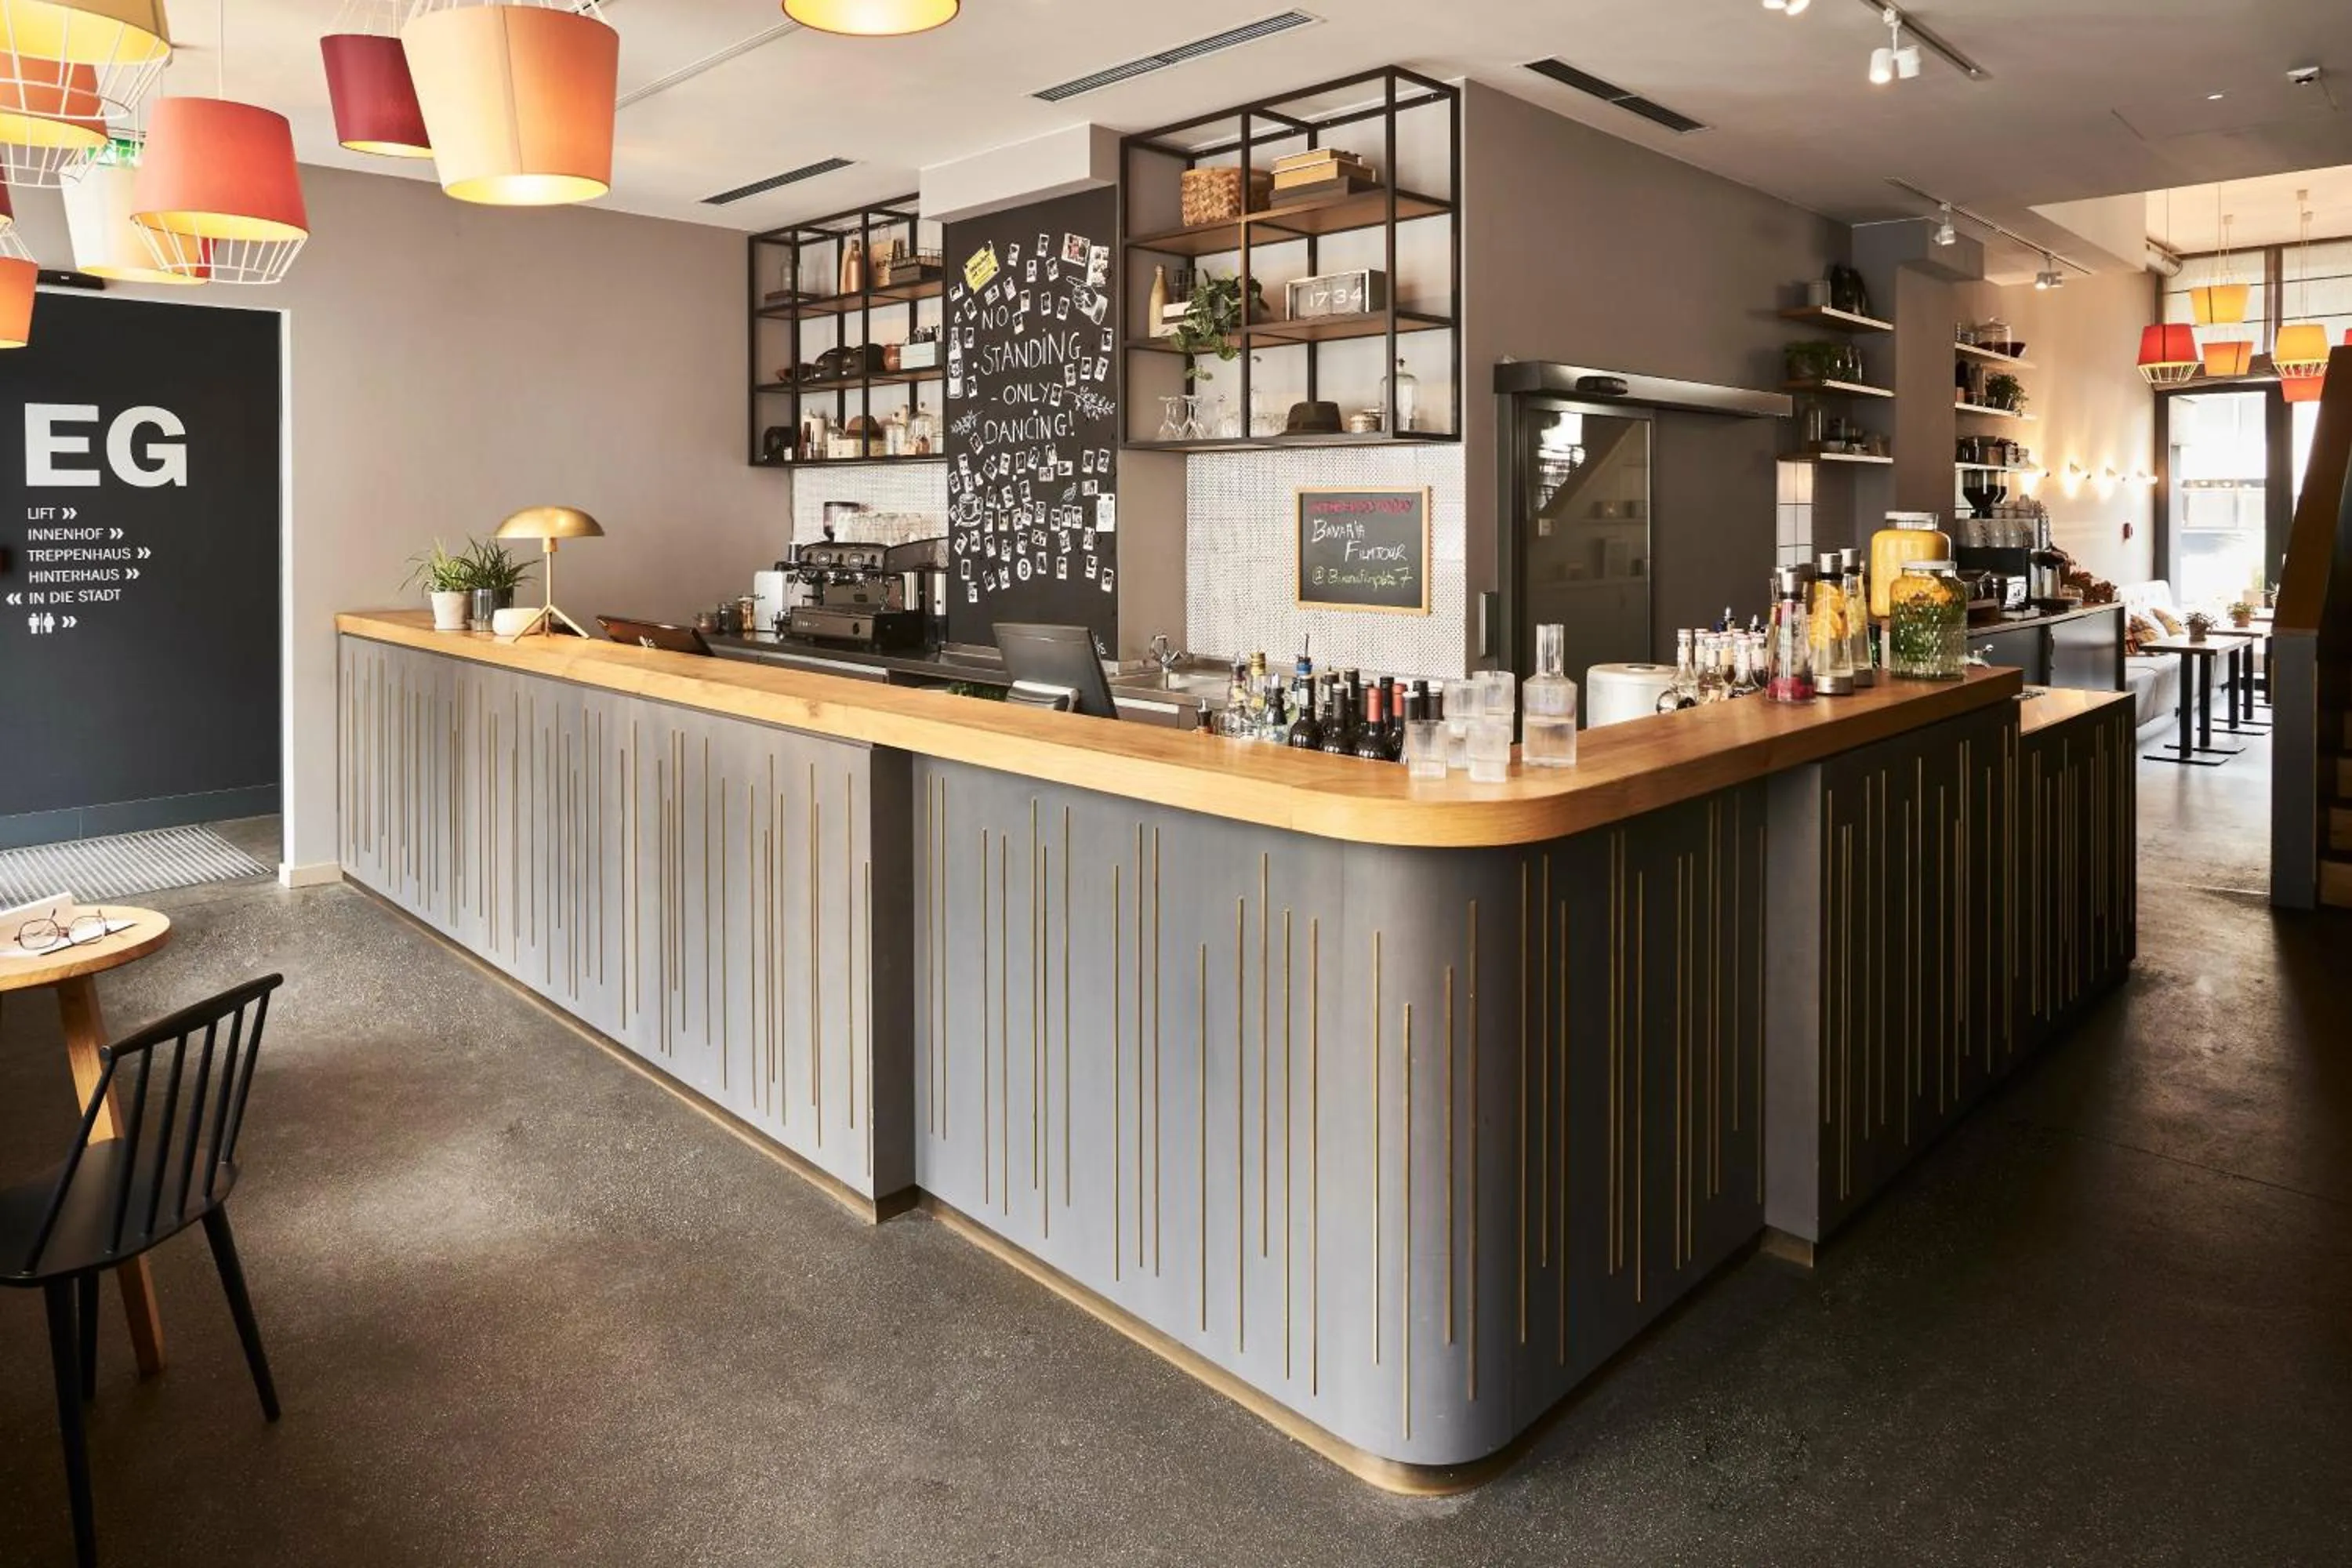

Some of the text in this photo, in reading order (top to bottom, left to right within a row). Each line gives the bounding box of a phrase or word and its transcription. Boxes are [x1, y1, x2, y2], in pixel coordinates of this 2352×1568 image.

[982, 305, 1010, 330] NO
[24, 402, 188, 488] EG
[27, 507, 56, 521] LIFT
[27, 528, 104, 541] INNENHOF
[27, 547, 132, 562] TREPPENHAUS
[28, 568, 121, 584] HINTERHAUS
[28, 588, 122, 605] IN DIE STADT
